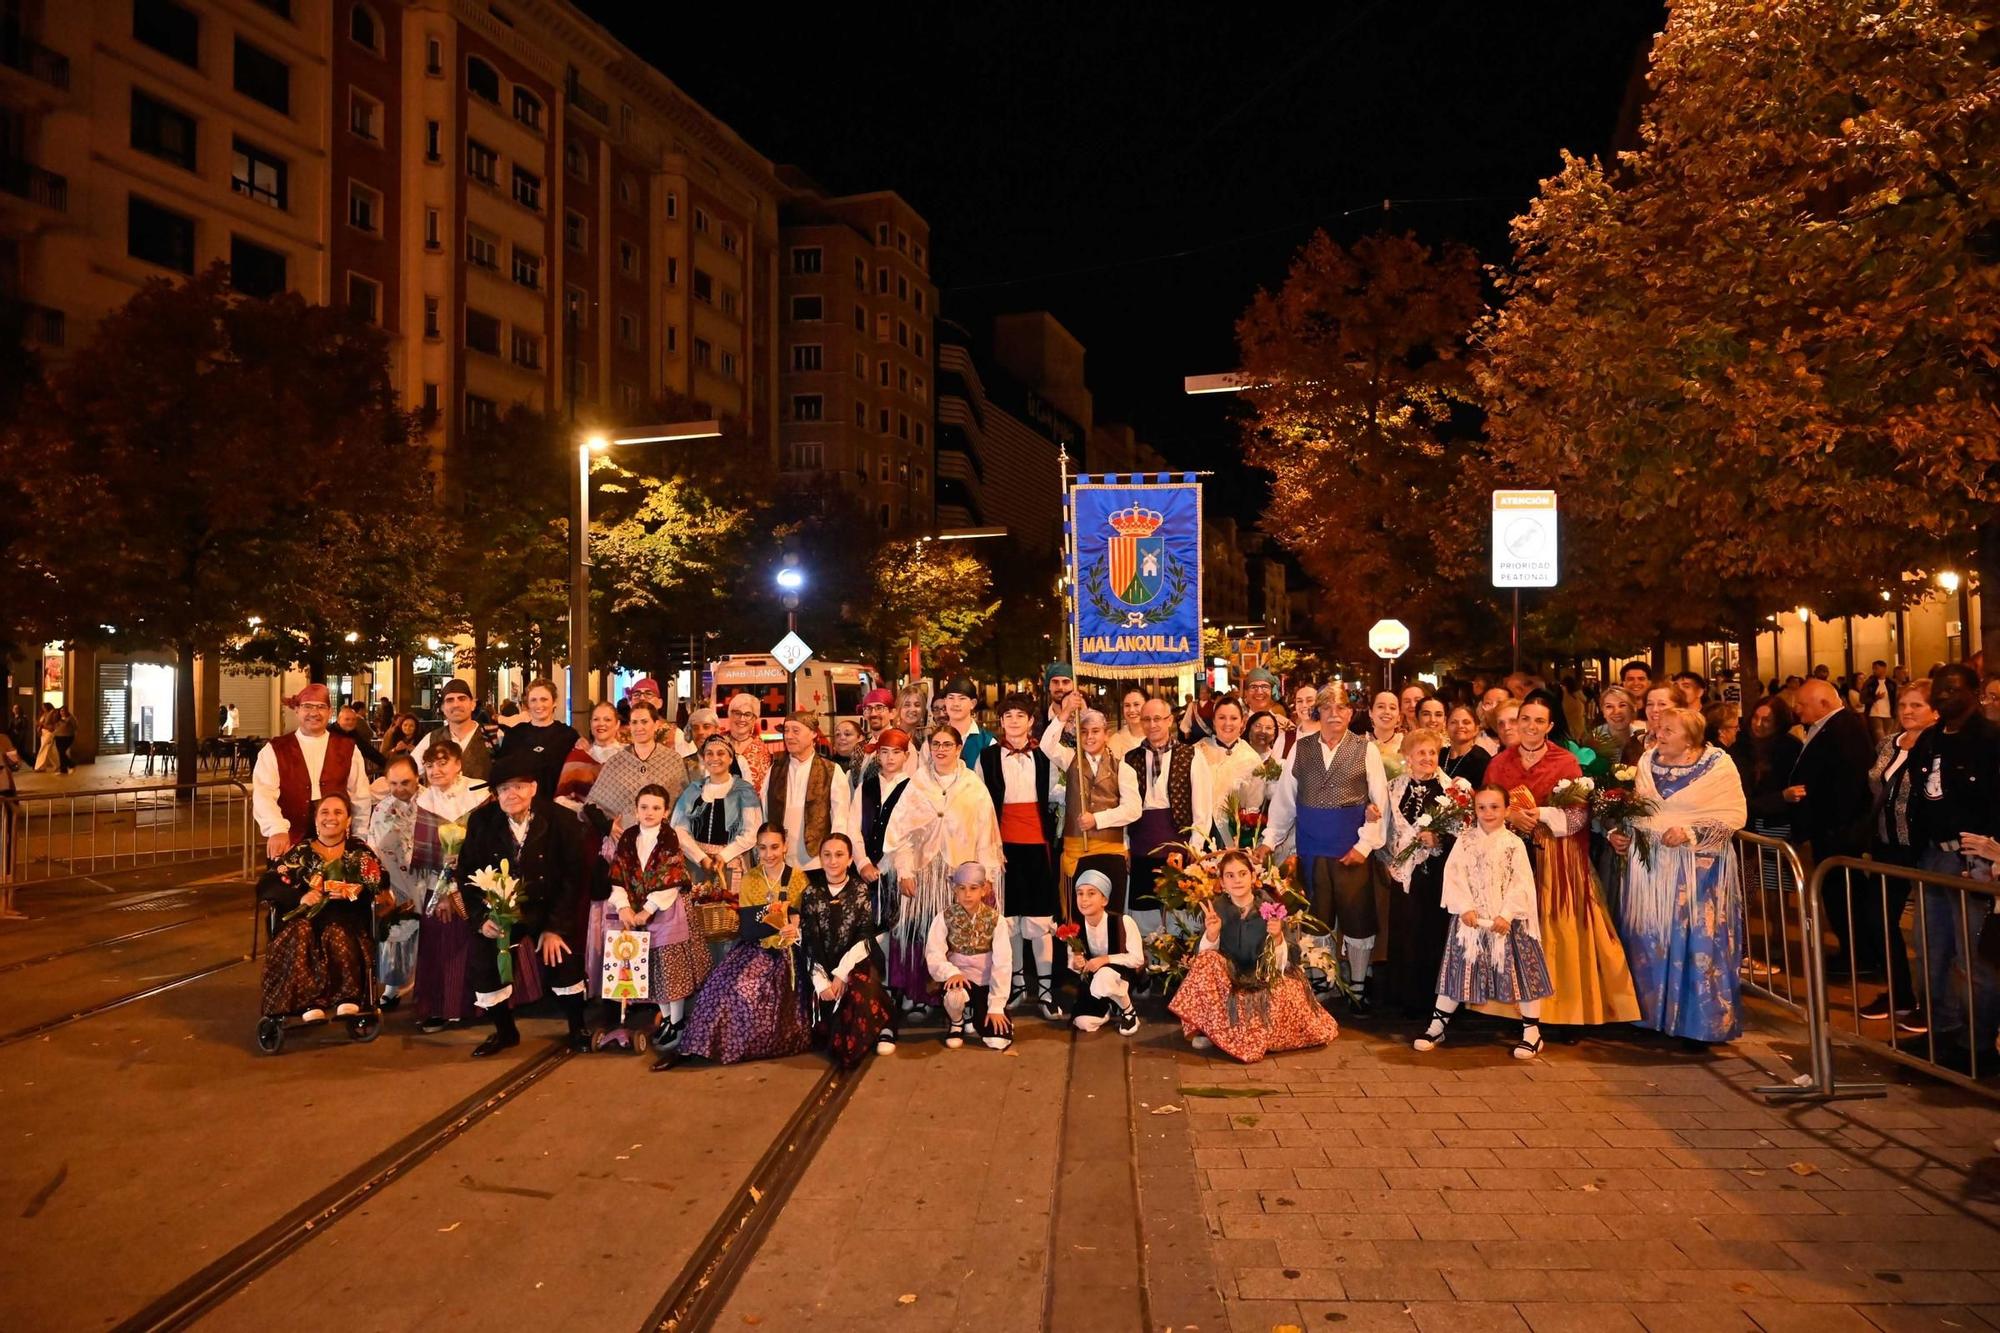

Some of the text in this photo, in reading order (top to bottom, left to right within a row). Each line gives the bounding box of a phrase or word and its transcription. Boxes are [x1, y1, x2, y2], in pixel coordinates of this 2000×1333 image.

[1500, 573, 1548, 581] PEATONAL
[1082, 635, 1190, 653] MALANQUILLA
[783, 645, 801, 659] 30
